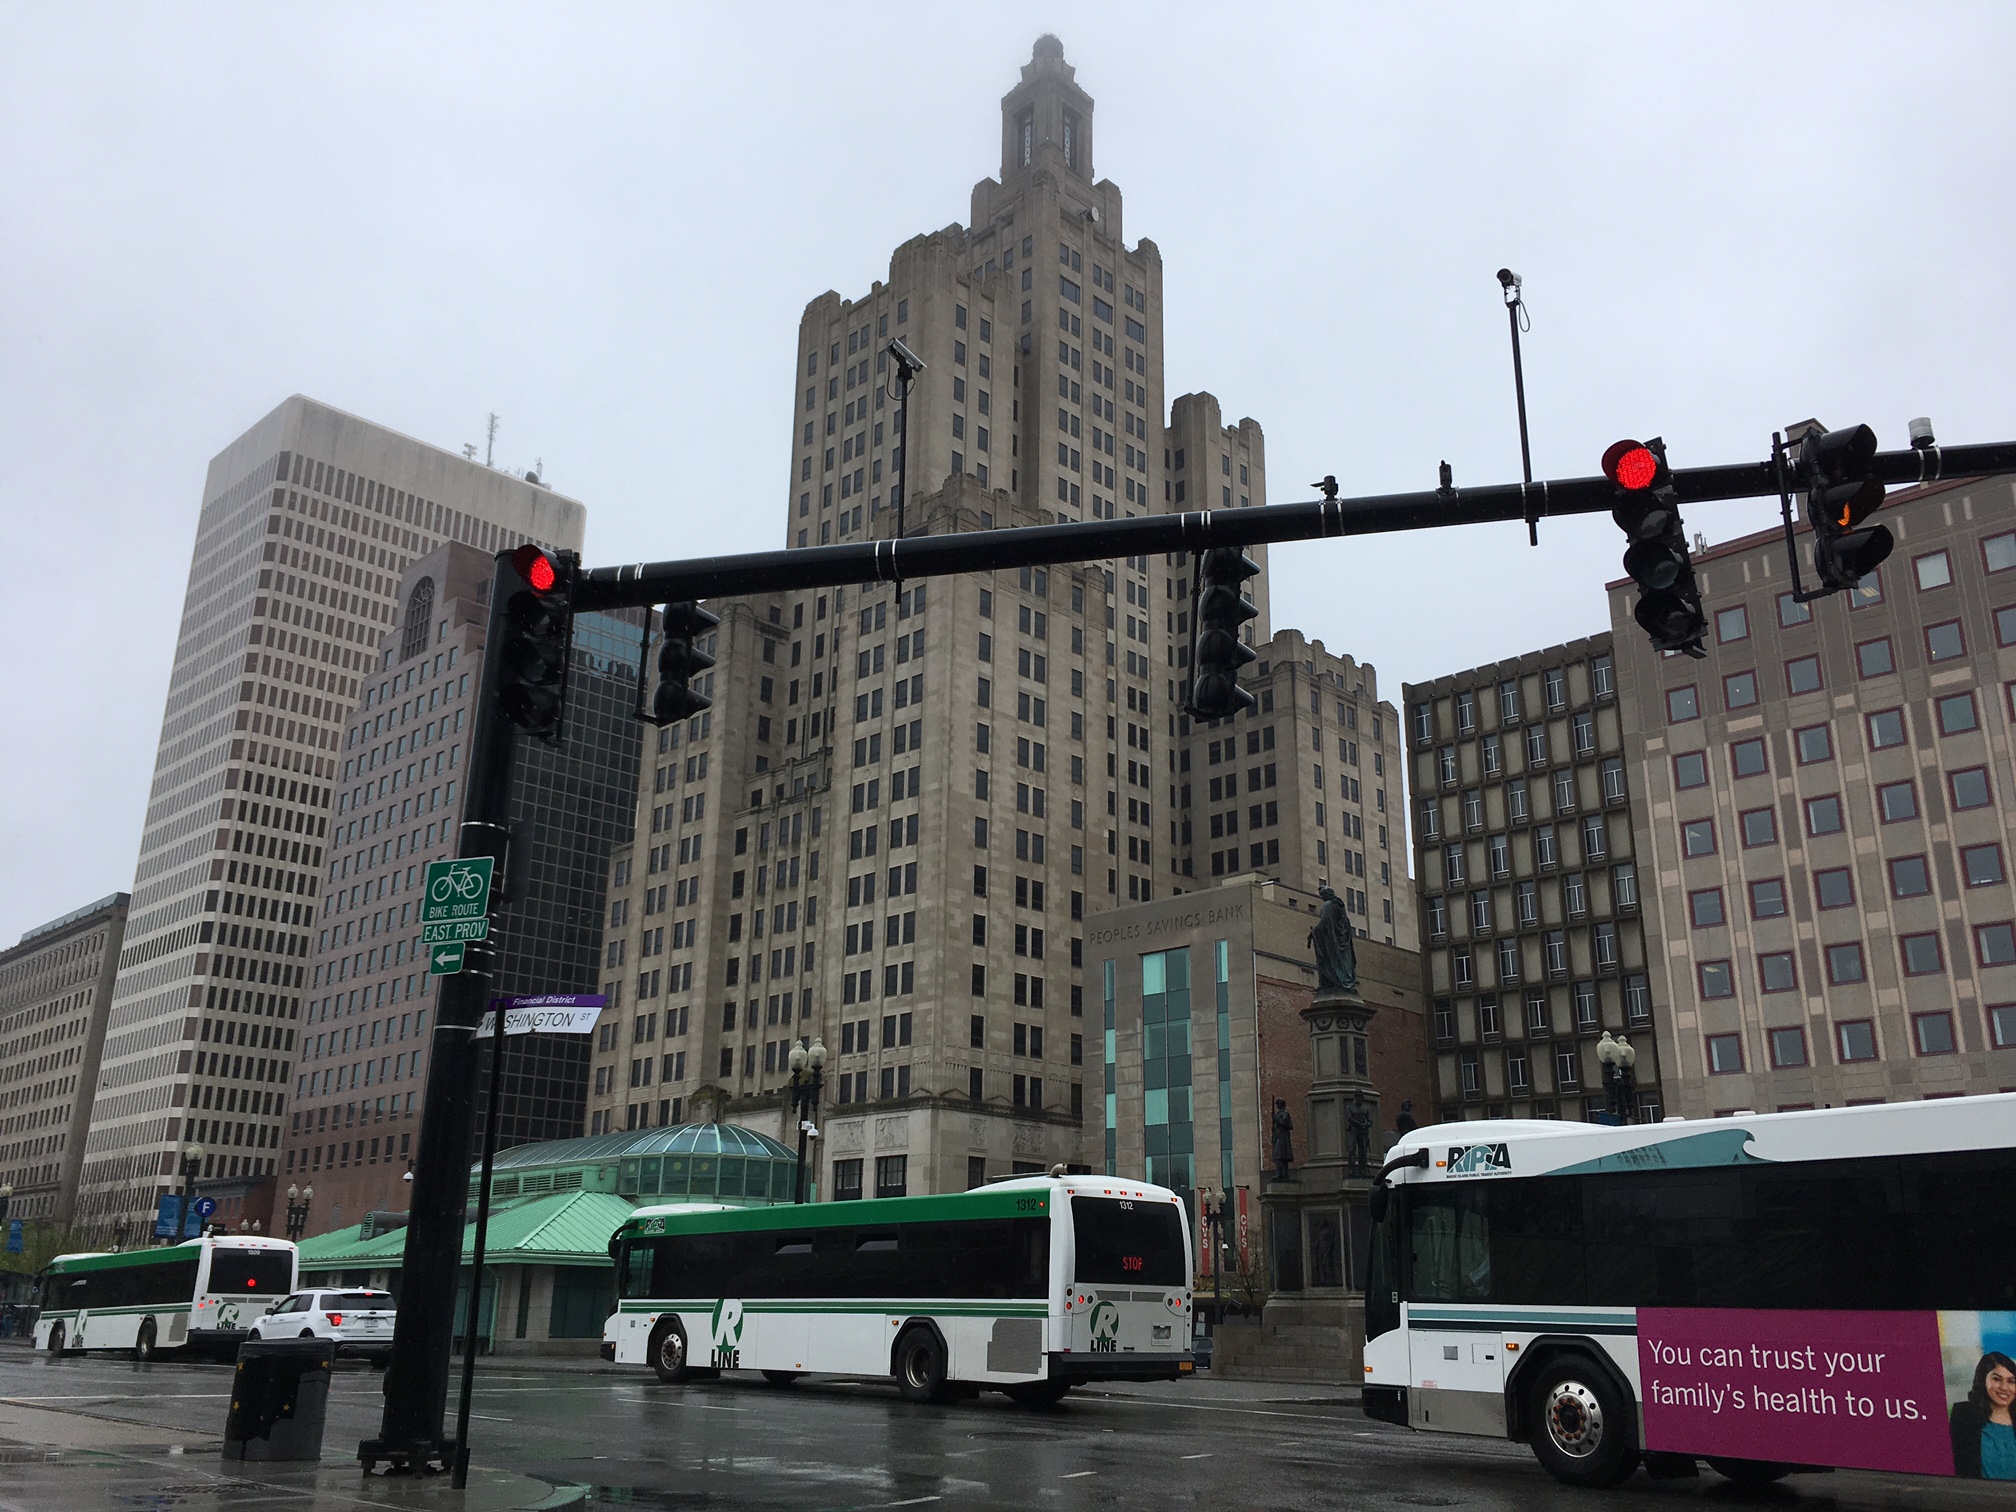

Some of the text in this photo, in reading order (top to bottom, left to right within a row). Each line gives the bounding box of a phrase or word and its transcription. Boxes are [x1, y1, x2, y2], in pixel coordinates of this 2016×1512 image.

[429, 902, 479, 919] BIKE ROUTE
[424, 921, 486, 941] EAST PROV
[1089, 904, 1244, 946] PEOPLES SAVINGS BANK
[512, 995, 577, 1006] Financial District
[485, 1012, 591, 1032] WSHINGTON ST
[1446, 1142, 1512, 1173] RIPTA
[202, 1201, 211, 1214] F
[1016, 1197, 1037, 1211] 1312
[1119, 1200, 1134, 1210] 1312
[1201, 1215, 1209, 1249] CVS
[1240, 1214, 1248, 1248] CVS
[715, 1298, 743, 1346] R
[1092, 1305, 1118, 1338] R
[1090, 1339, 1117, 1352] LINE
[710, 1348, 740, 1368] LINE
[1648, 1339, 1886, 1378] You can trust your
[1651, 1380, 1928, 1420] family's health to us.
